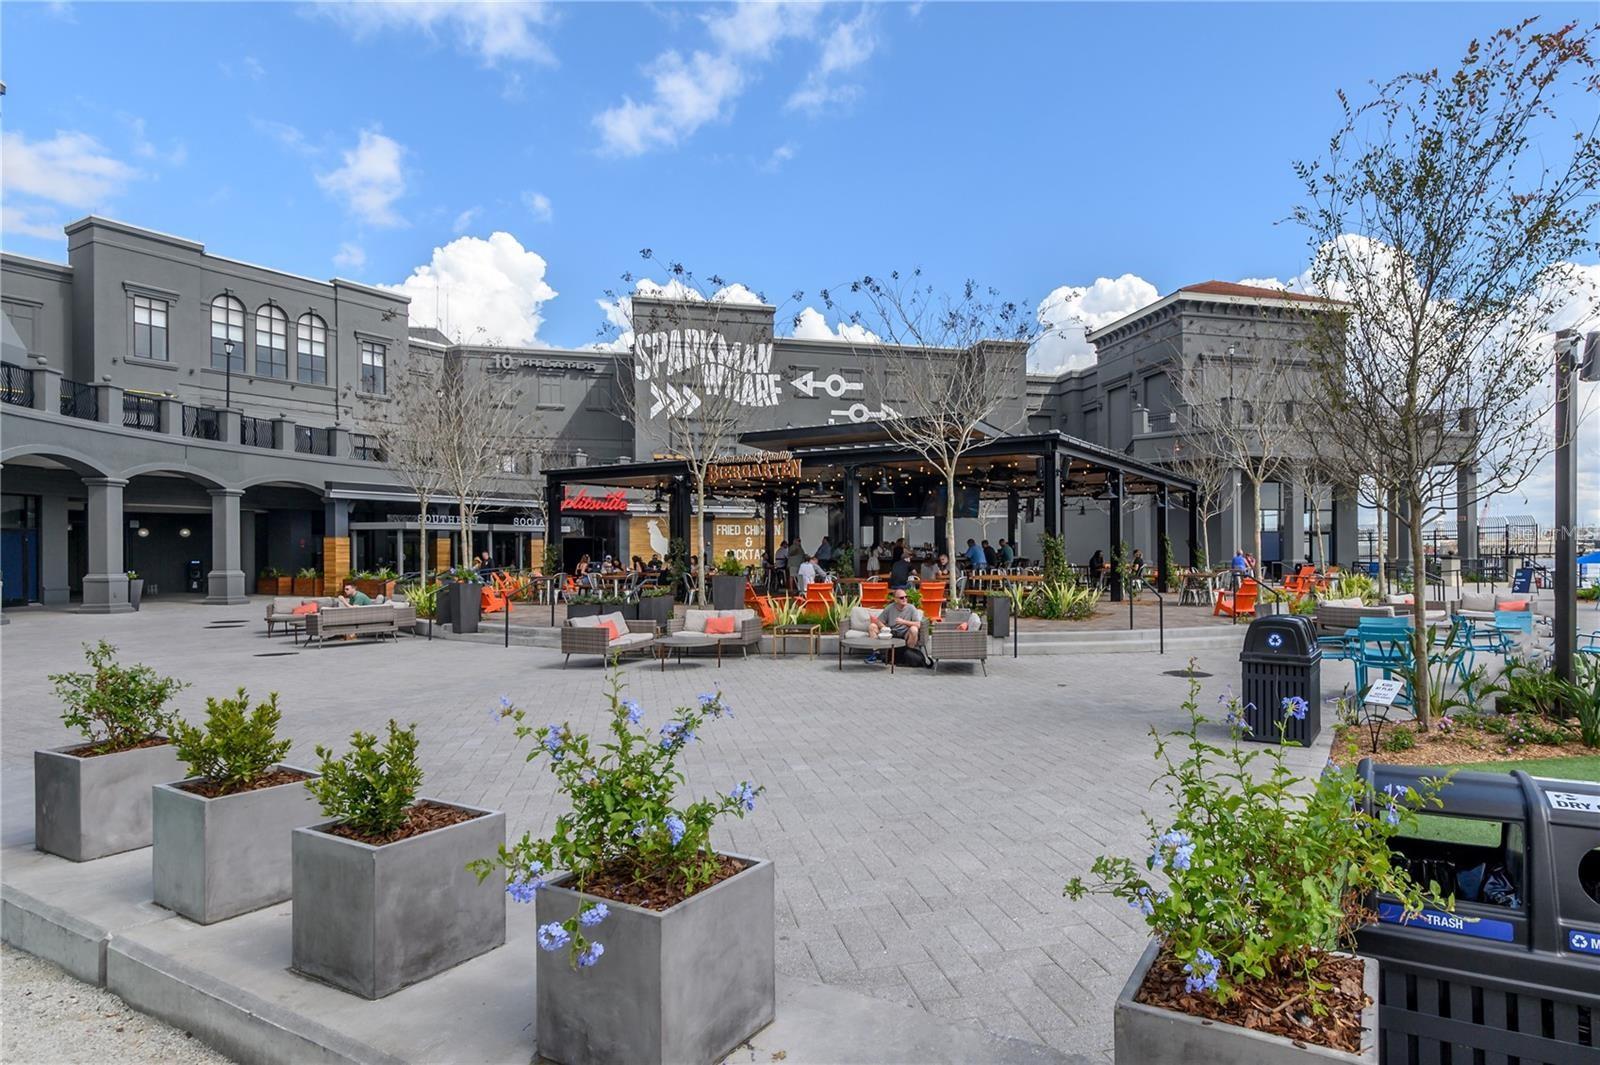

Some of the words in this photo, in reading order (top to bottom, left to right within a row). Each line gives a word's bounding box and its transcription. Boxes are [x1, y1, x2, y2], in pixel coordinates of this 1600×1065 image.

[635, 329, 773, 380] SPARKMAN
[701, 364, 782, 407] WHARF
[707, 459, 801, 483] BIERGARTEN
[561, 486, 628, 511] plitsville
[513, 517, 546, 527] SOCIA
[716, 525, 740, 535] FRIED
[745, 537, 752, 547] &
[1556, 800, 1591, 811] DRY
[1427, 915, 1463, 930] TRASH
